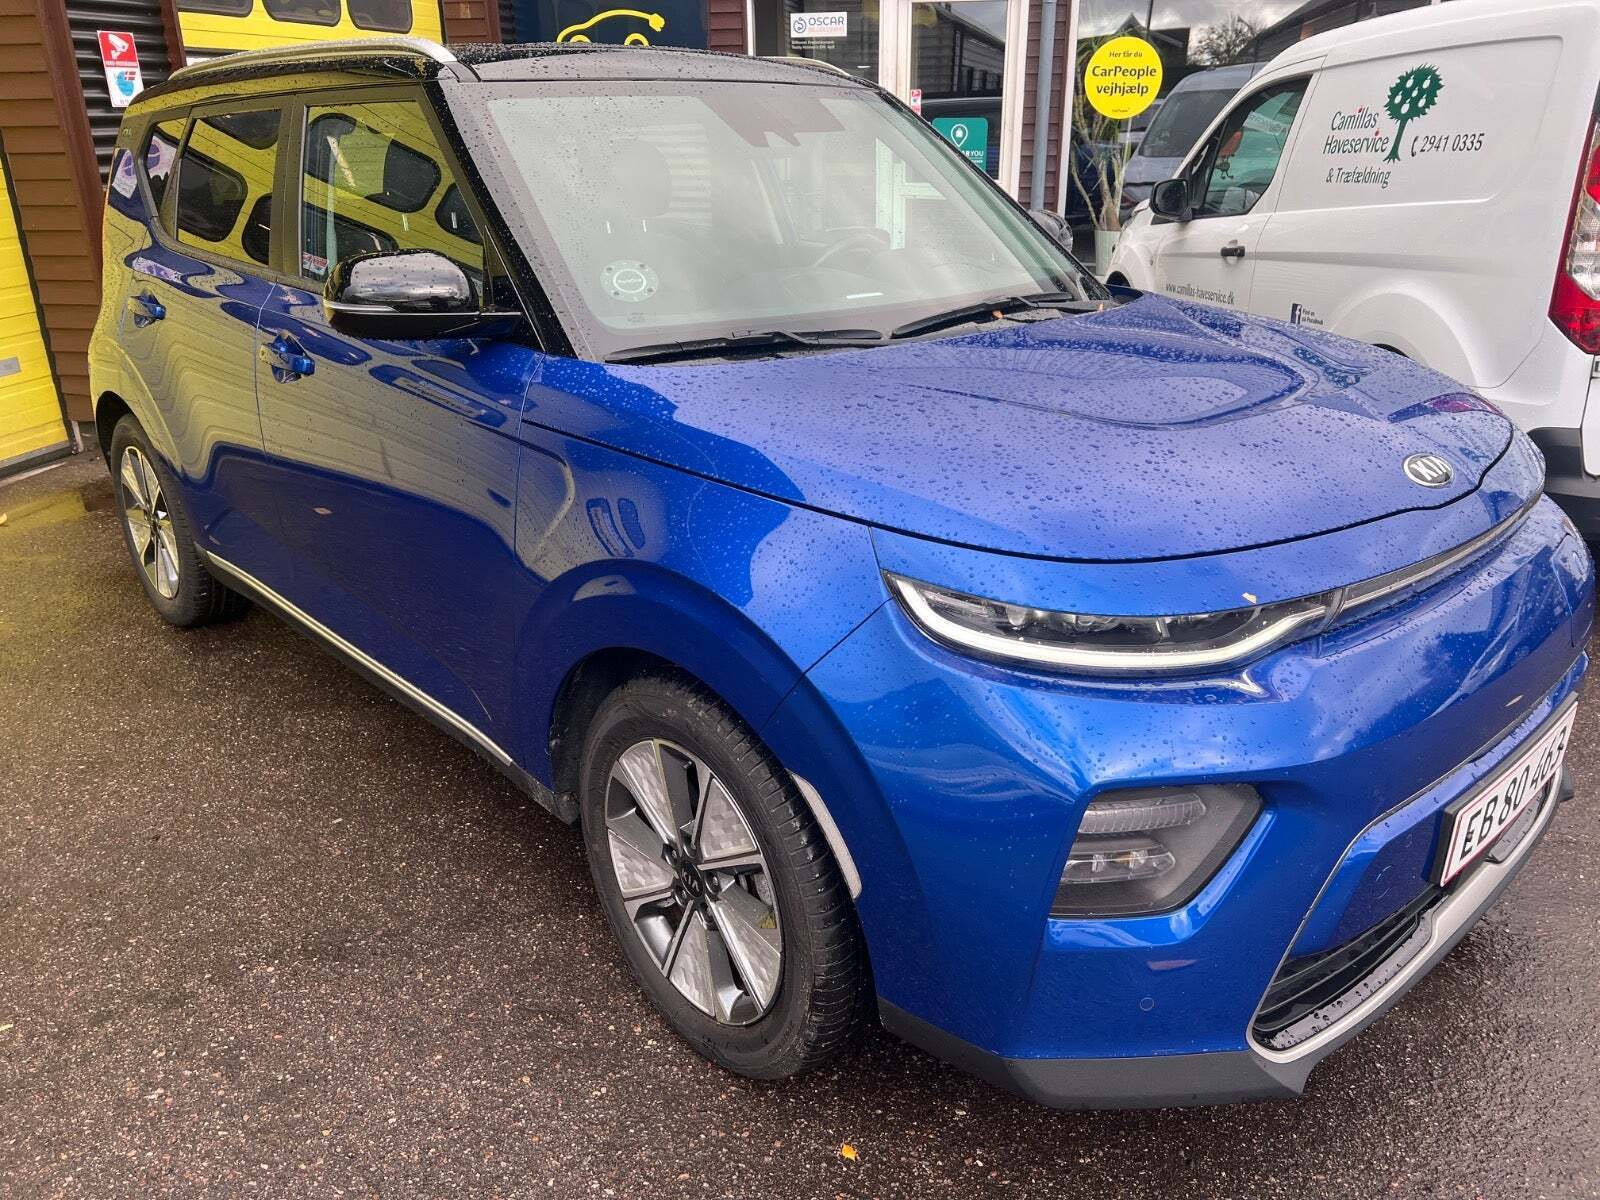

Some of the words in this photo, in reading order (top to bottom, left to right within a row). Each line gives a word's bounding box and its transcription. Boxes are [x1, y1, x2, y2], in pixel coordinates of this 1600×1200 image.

[808, 16, 845, 26] OSCAR
[1092, 65, 1157, 80] CarPeople
[1096, 82, 1149, 97] vejhjælp
[1331, 106, 1380, 131] Camillas
[1323, 131, 1390, 155] Haveservice
[1419, 135, 1450, 153] 2941
[1452, 133, 1485, 152] 0335
[1325, 167, 1334, 184] &
[1335, 166, 1392, 189] Træfældning
[1460, 794, 1499, 861] EB
[1499, 764, 1531, 826] 80
[1530, 726, 1567, 789] 463
